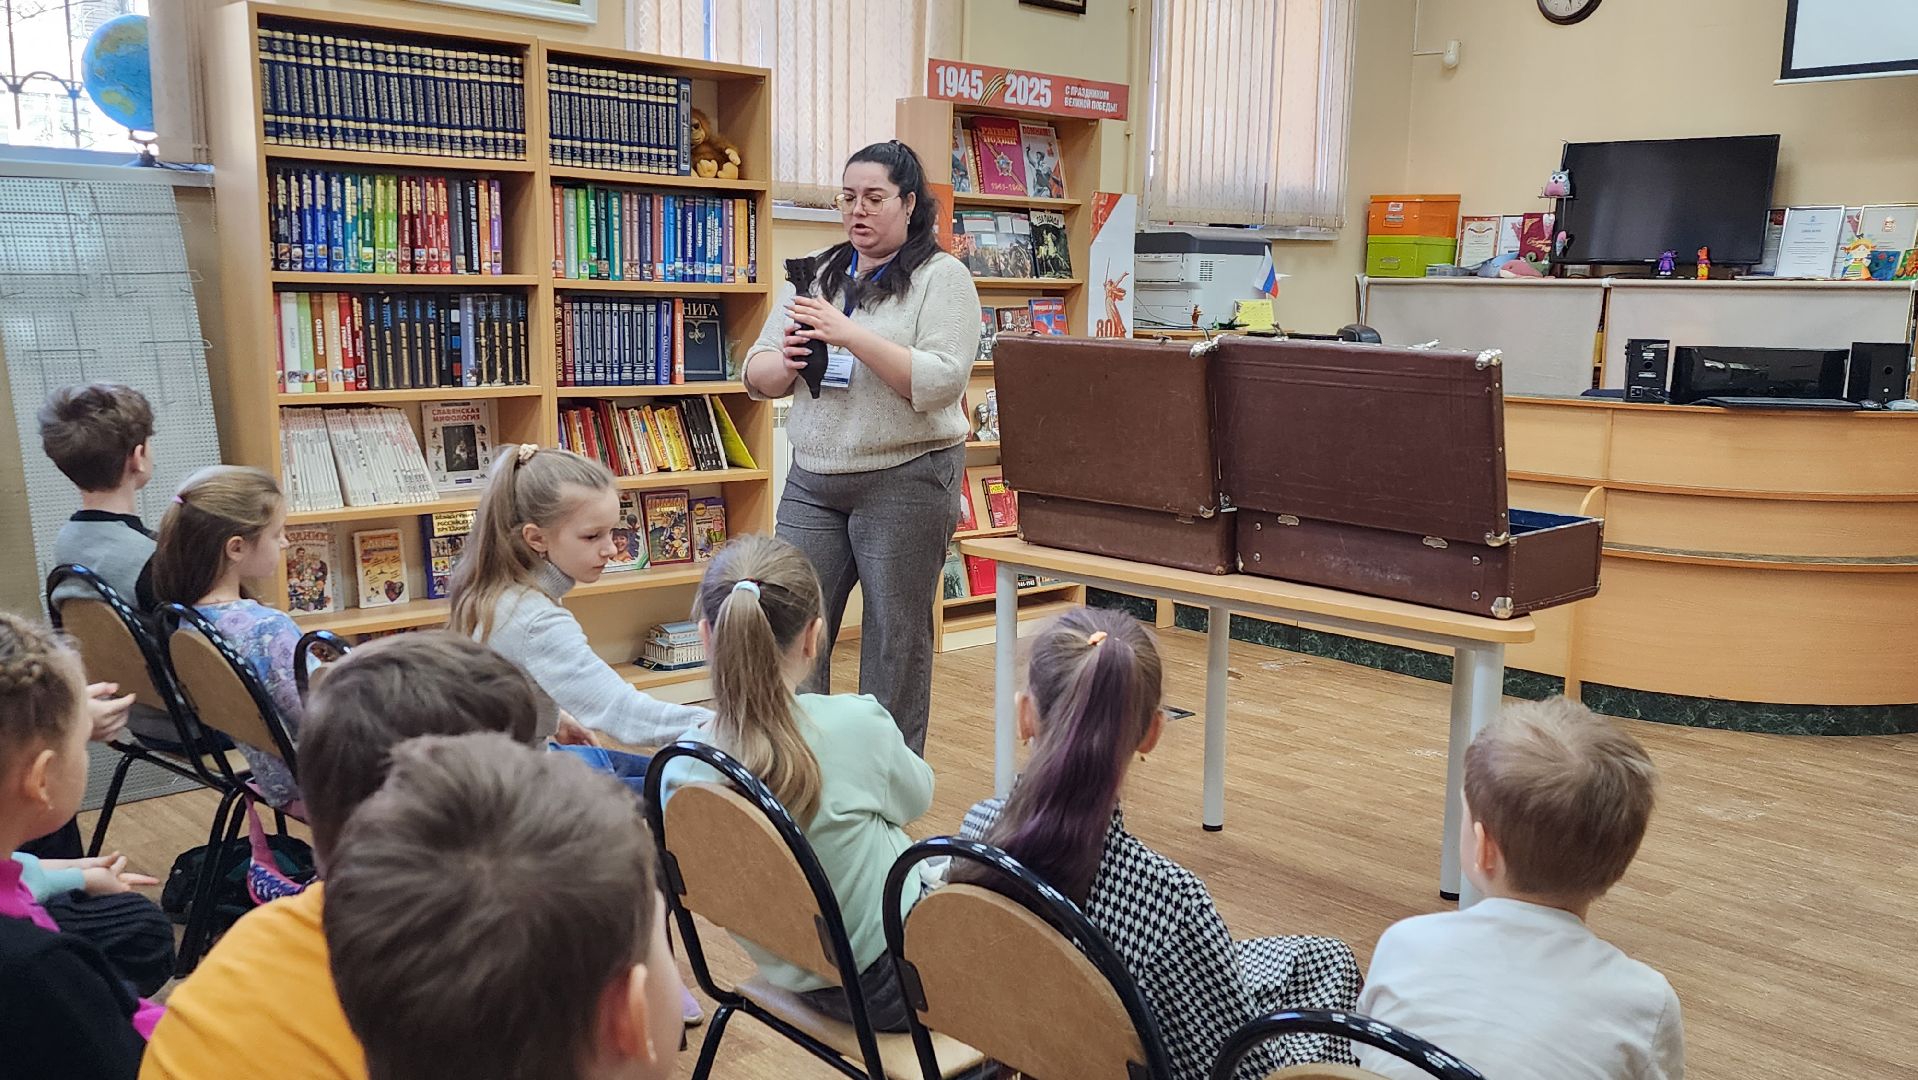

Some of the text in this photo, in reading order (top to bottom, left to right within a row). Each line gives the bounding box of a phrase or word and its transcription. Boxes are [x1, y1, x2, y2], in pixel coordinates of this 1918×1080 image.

[936, 65, 1052, 108] 1945 2025
[1065, 85, 1109, 100] С ПРАЗДНИКОМ
[1064, 97, 1118, 112] ВЕЛИКОЙ ПОБЕДЫ!
[471, 222, 479, 270] ЭНЦИКЛОПЕДИЯ
[682, 303, 718, 316] НИГА
[315, 319, 324, 355] ОБЩЕСТВО
[433, 414, 480, 422] МИФОЛОГИЯ
